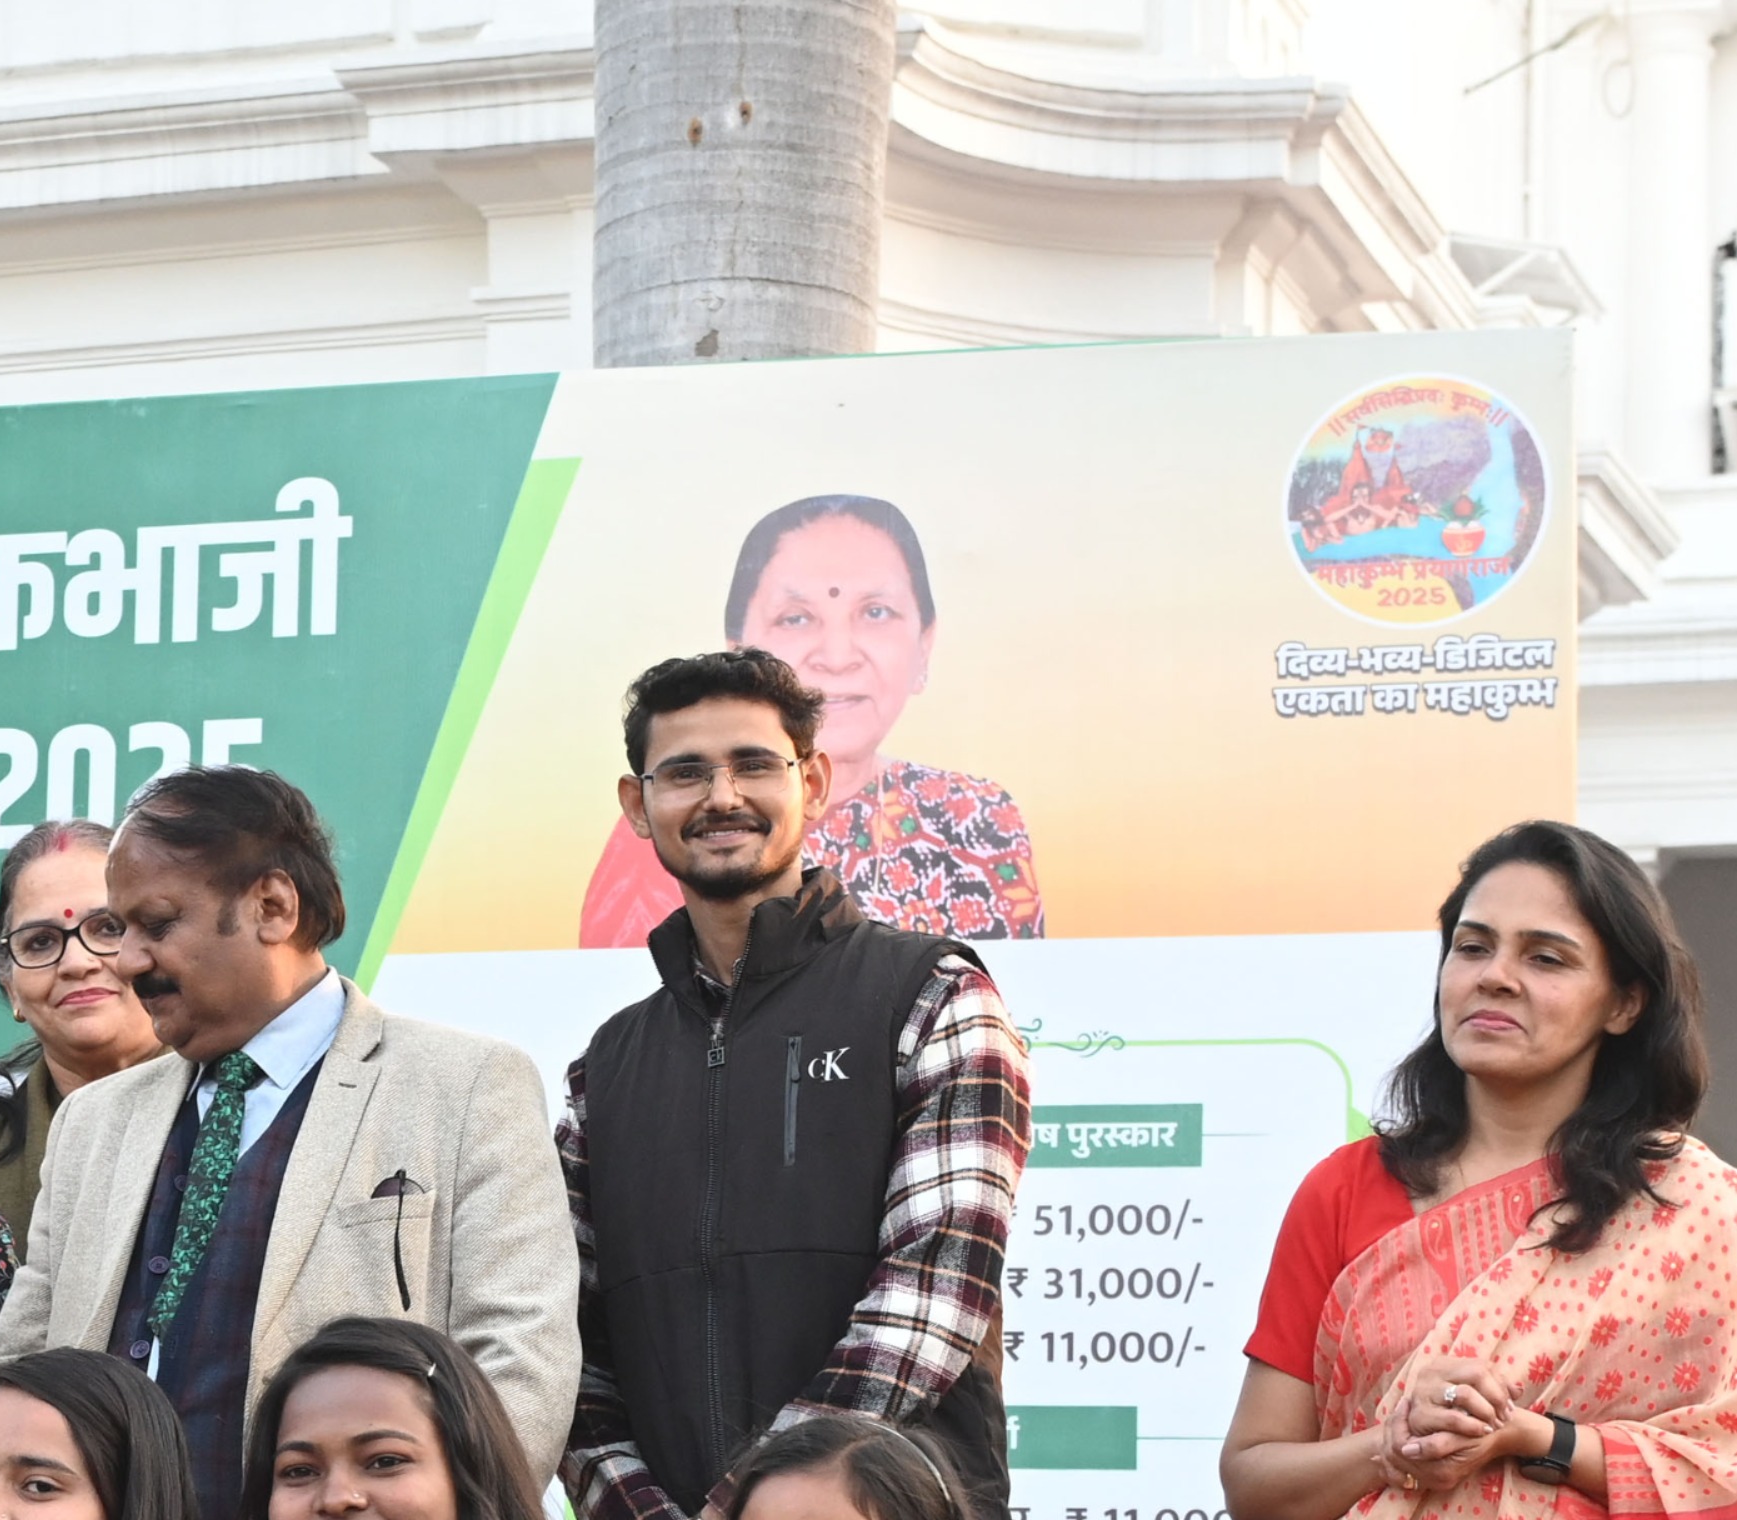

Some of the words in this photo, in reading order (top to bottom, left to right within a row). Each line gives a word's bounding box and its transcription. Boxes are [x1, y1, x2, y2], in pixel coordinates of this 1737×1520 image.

[1377, 586, 1447, 608] 2025
[1275, 635, 1556, 679] दिव्य-भव्य-डिजिटल
[1273, 683, 1365, 719] एकता
[1370, 682, 1418, 714] का
[1423, 677, 1558, 721] महाकुम्भ
[1065, 1121, 1179, 1159] पुरस्कार
[1032, 1198, 1204, 1243] 51,000/-
[1043, 1262, 1214, 1307] 31,000/-
[1040, 1326, 1206, 1370] 11,000/-
